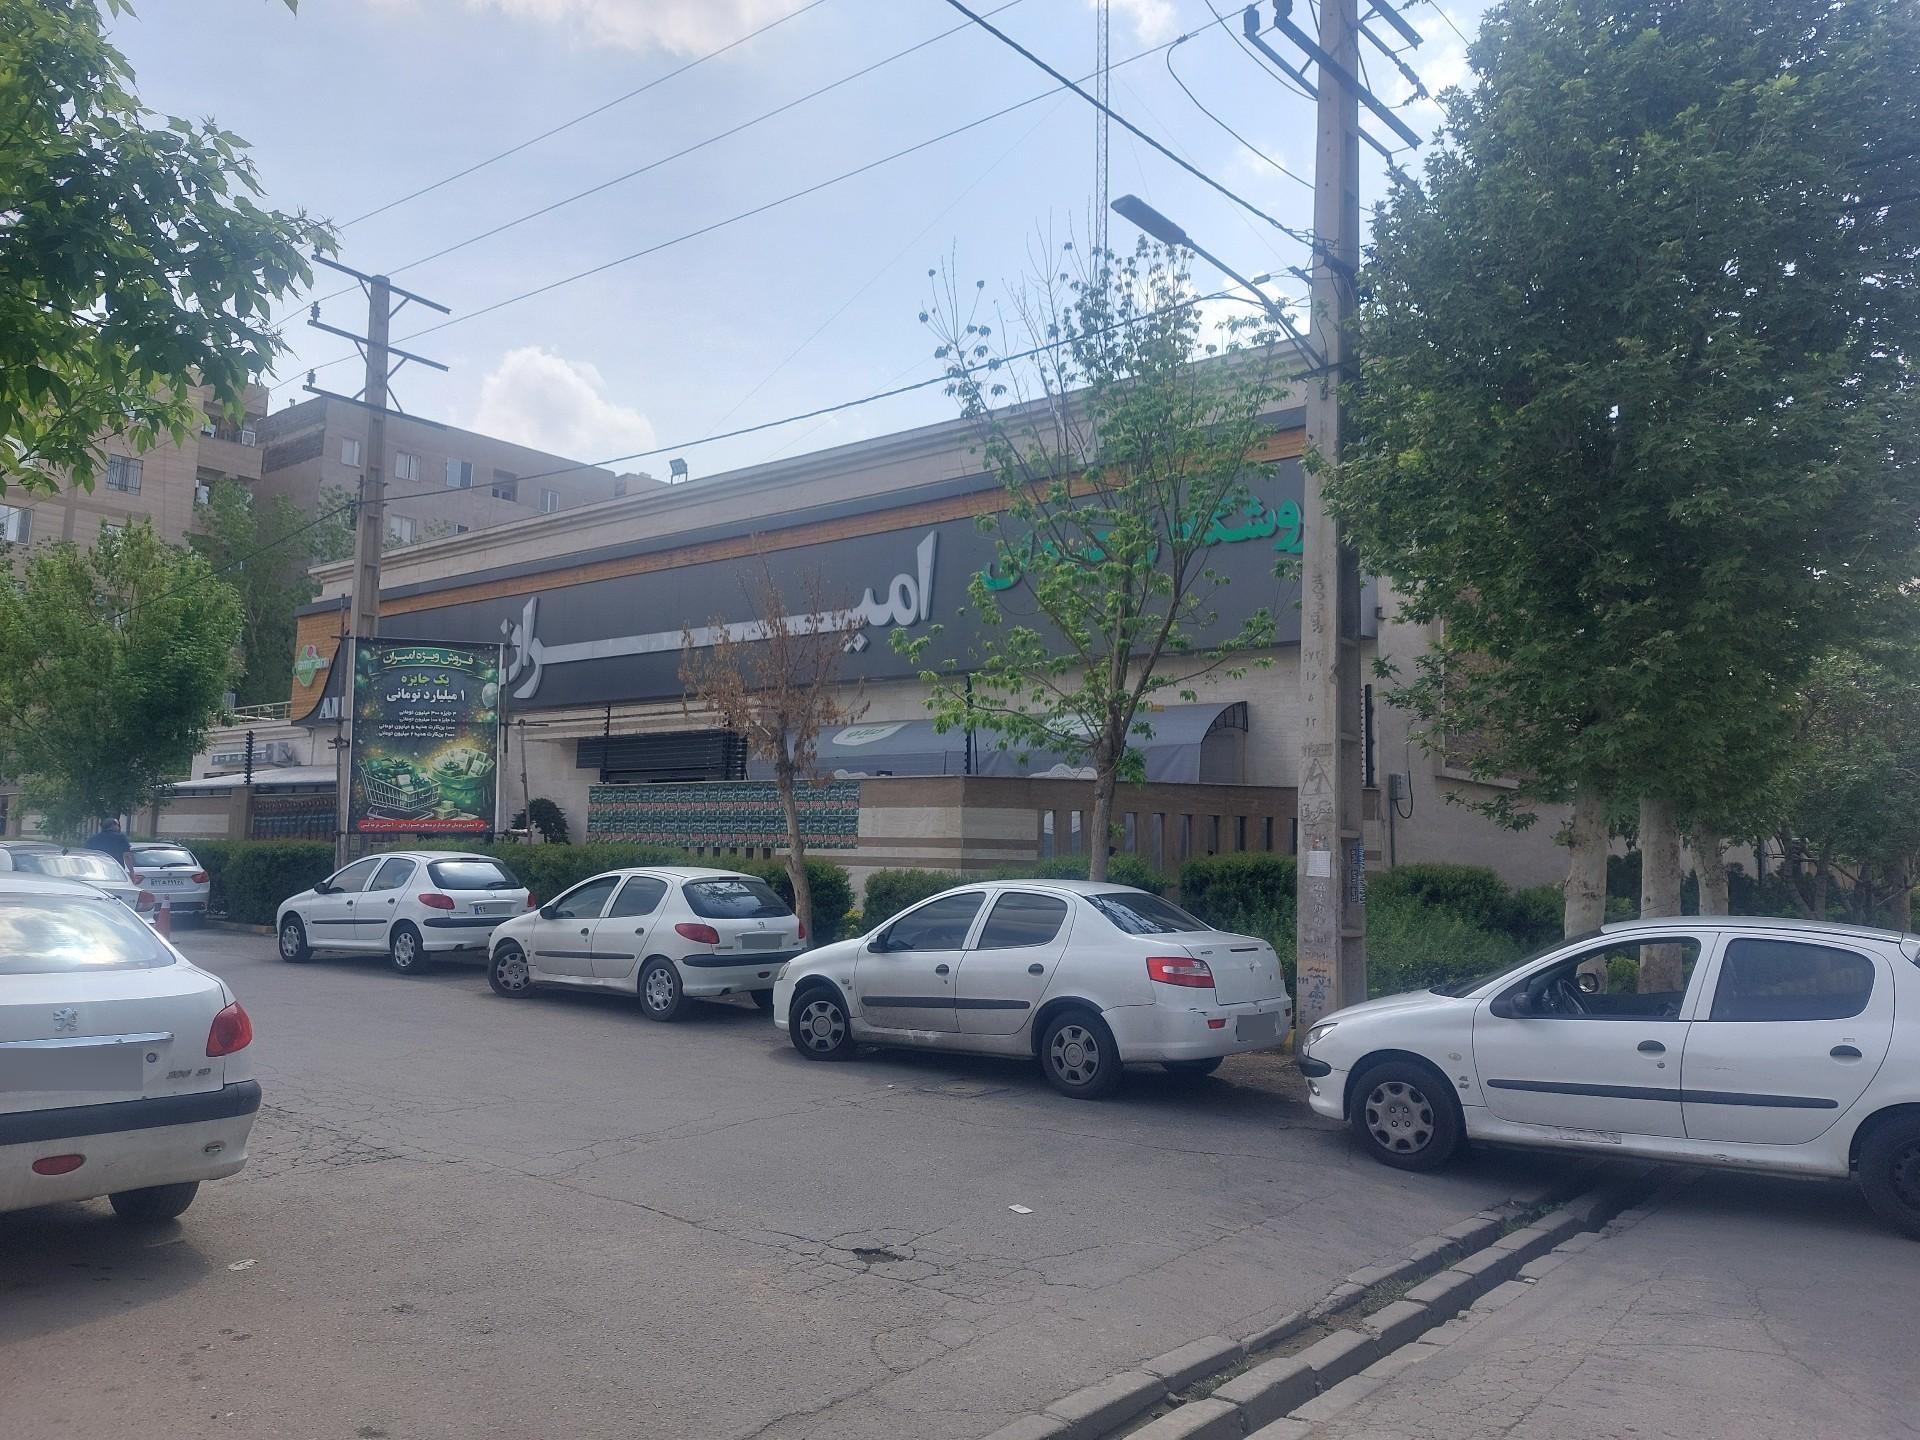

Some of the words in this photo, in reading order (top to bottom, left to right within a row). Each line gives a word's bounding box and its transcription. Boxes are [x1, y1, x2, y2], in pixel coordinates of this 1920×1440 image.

[401, 673, 429, 686] جایزه
[433, 673, 450, 686] یک
[386, 688, 422, 702] تومانی
[423, 688, 458, 703] میلیارد
